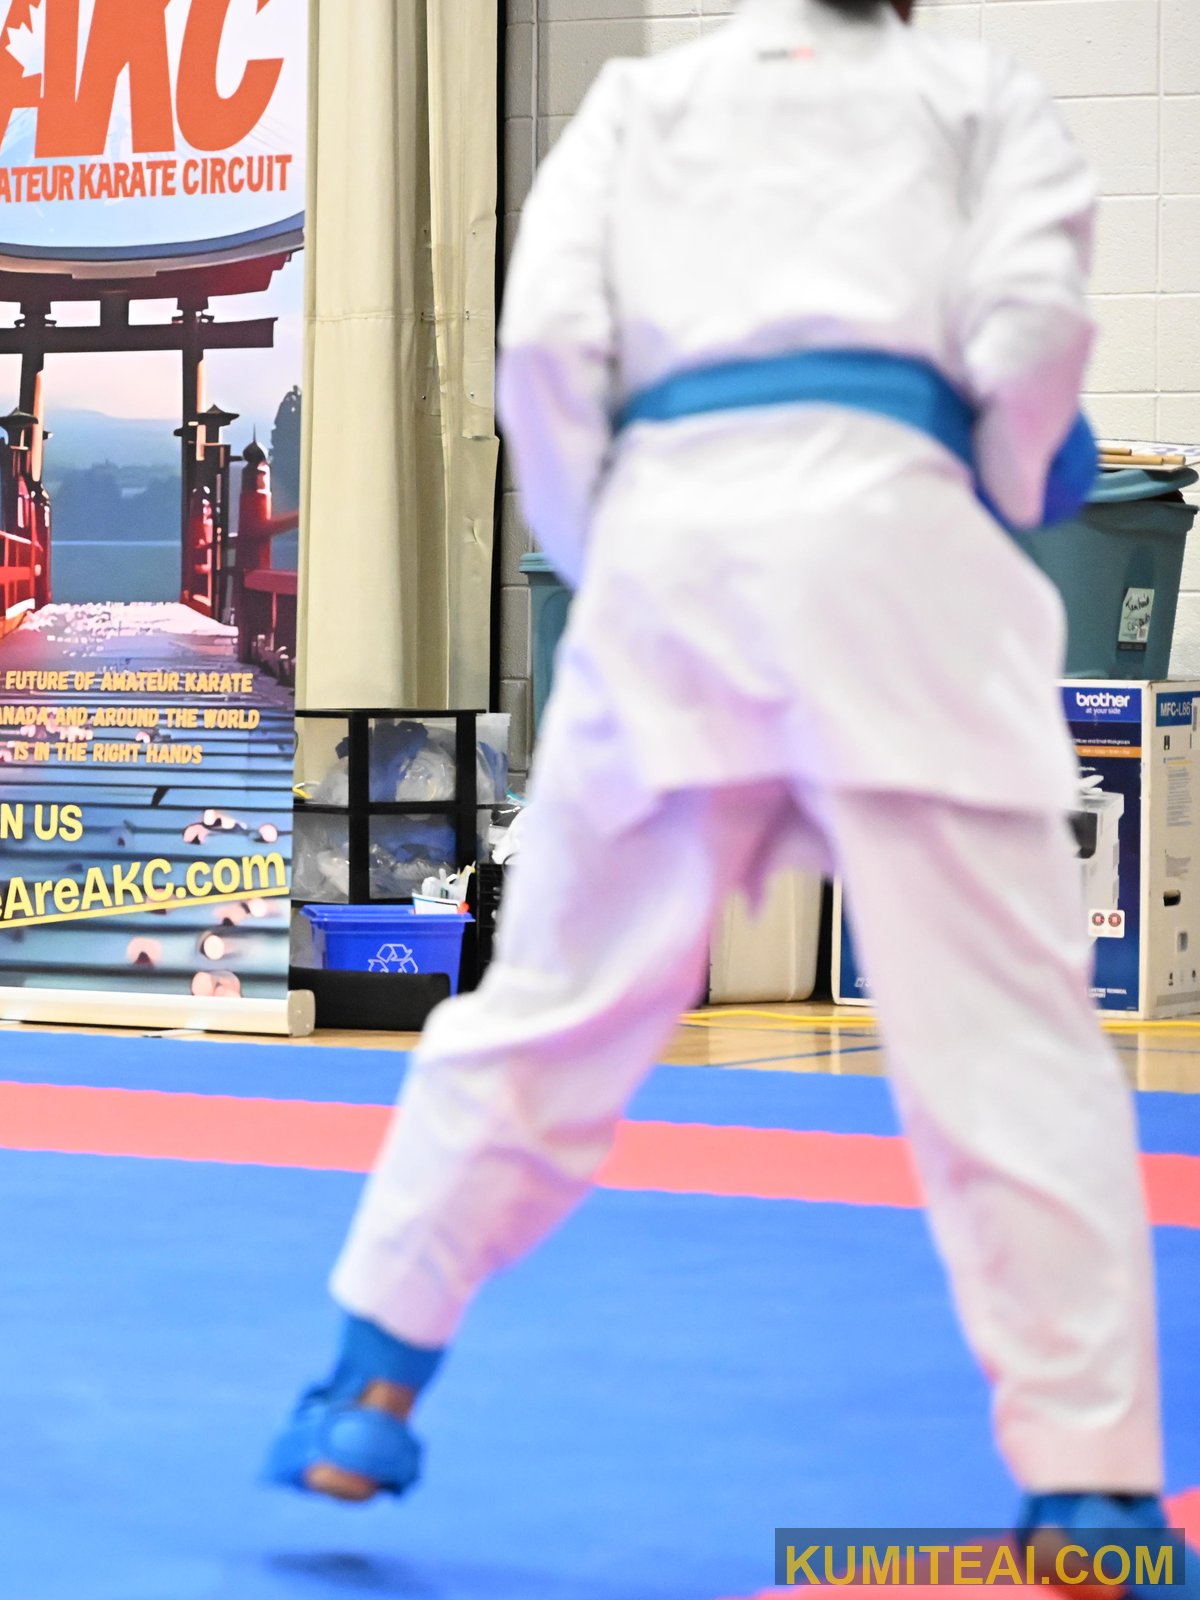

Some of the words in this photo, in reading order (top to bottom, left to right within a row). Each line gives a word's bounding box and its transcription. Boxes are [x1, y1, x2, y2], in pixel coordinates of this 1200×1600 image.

[78, 160, 177, 200] KARATE
[182, 154, 292, 195] CIRCUIT
[5, 670, 70, 691] FUTURE
[73, 671, 96, 691] OF
[100, 671, 180, 692] AMATEUR
[184, 672, 254, 693] KARATE
[1075, 692, 1131, 707] brother
[55, 706, 88, 726] AND
[92, 707, 160, 727] AROUND
[166, 708, 199, 728] THE
[203, 708, 260, 729] WORLD
[1093, 708, 1108, 717] your
[1108, 707, 1121, 715] side
[13, 741, 29, 761] IS
[33, 741, 50, 761] IN
[55, 742, 88, 762] THE
[92, 742, 141, 763] RIGHT
[146, 743, 203, 764] HANDS
[33, 804, 84, 842] US
